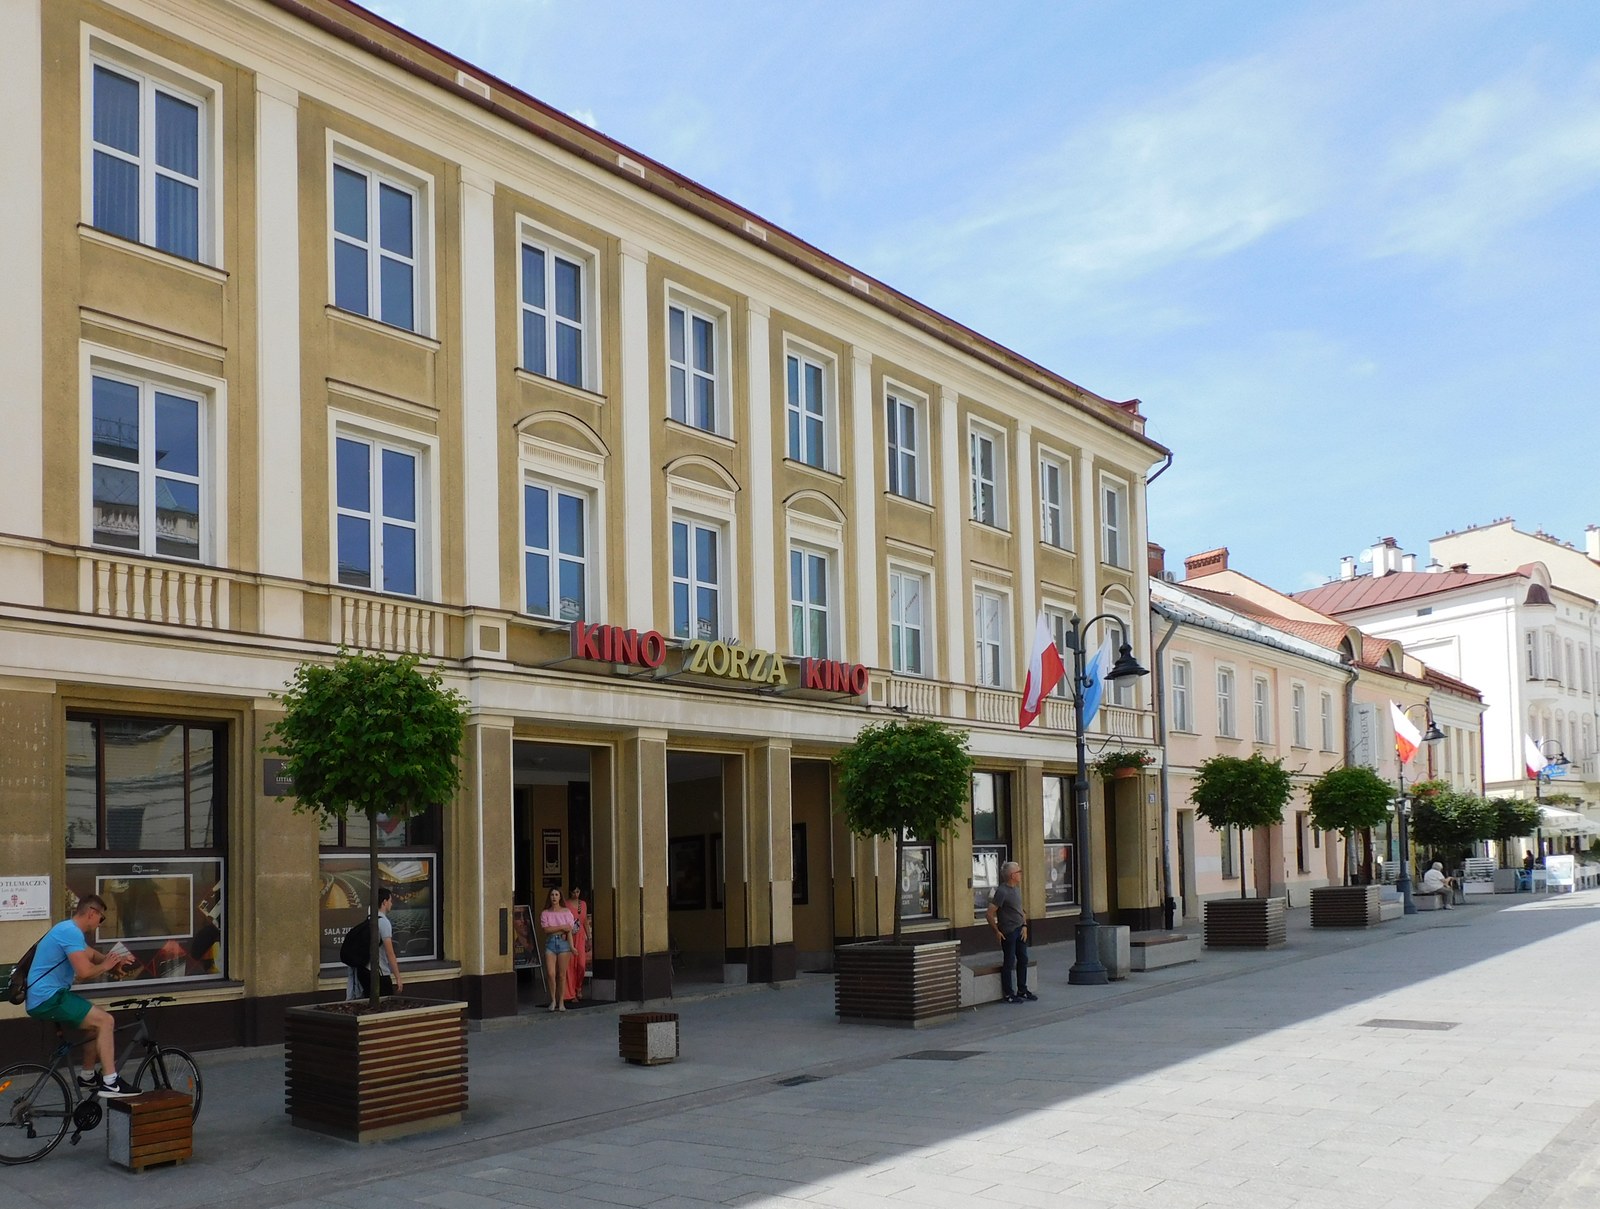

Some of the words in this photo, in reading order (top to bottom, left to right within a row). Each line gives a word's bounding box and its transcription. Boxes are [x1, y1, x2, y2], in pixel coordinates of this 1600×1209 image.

[575, 620, 667, 668] KINO
[688, 639, 788, 685] ZORZA
[805, 656, 869, 696] KINO
[323, 927, 341, 936] SALA
